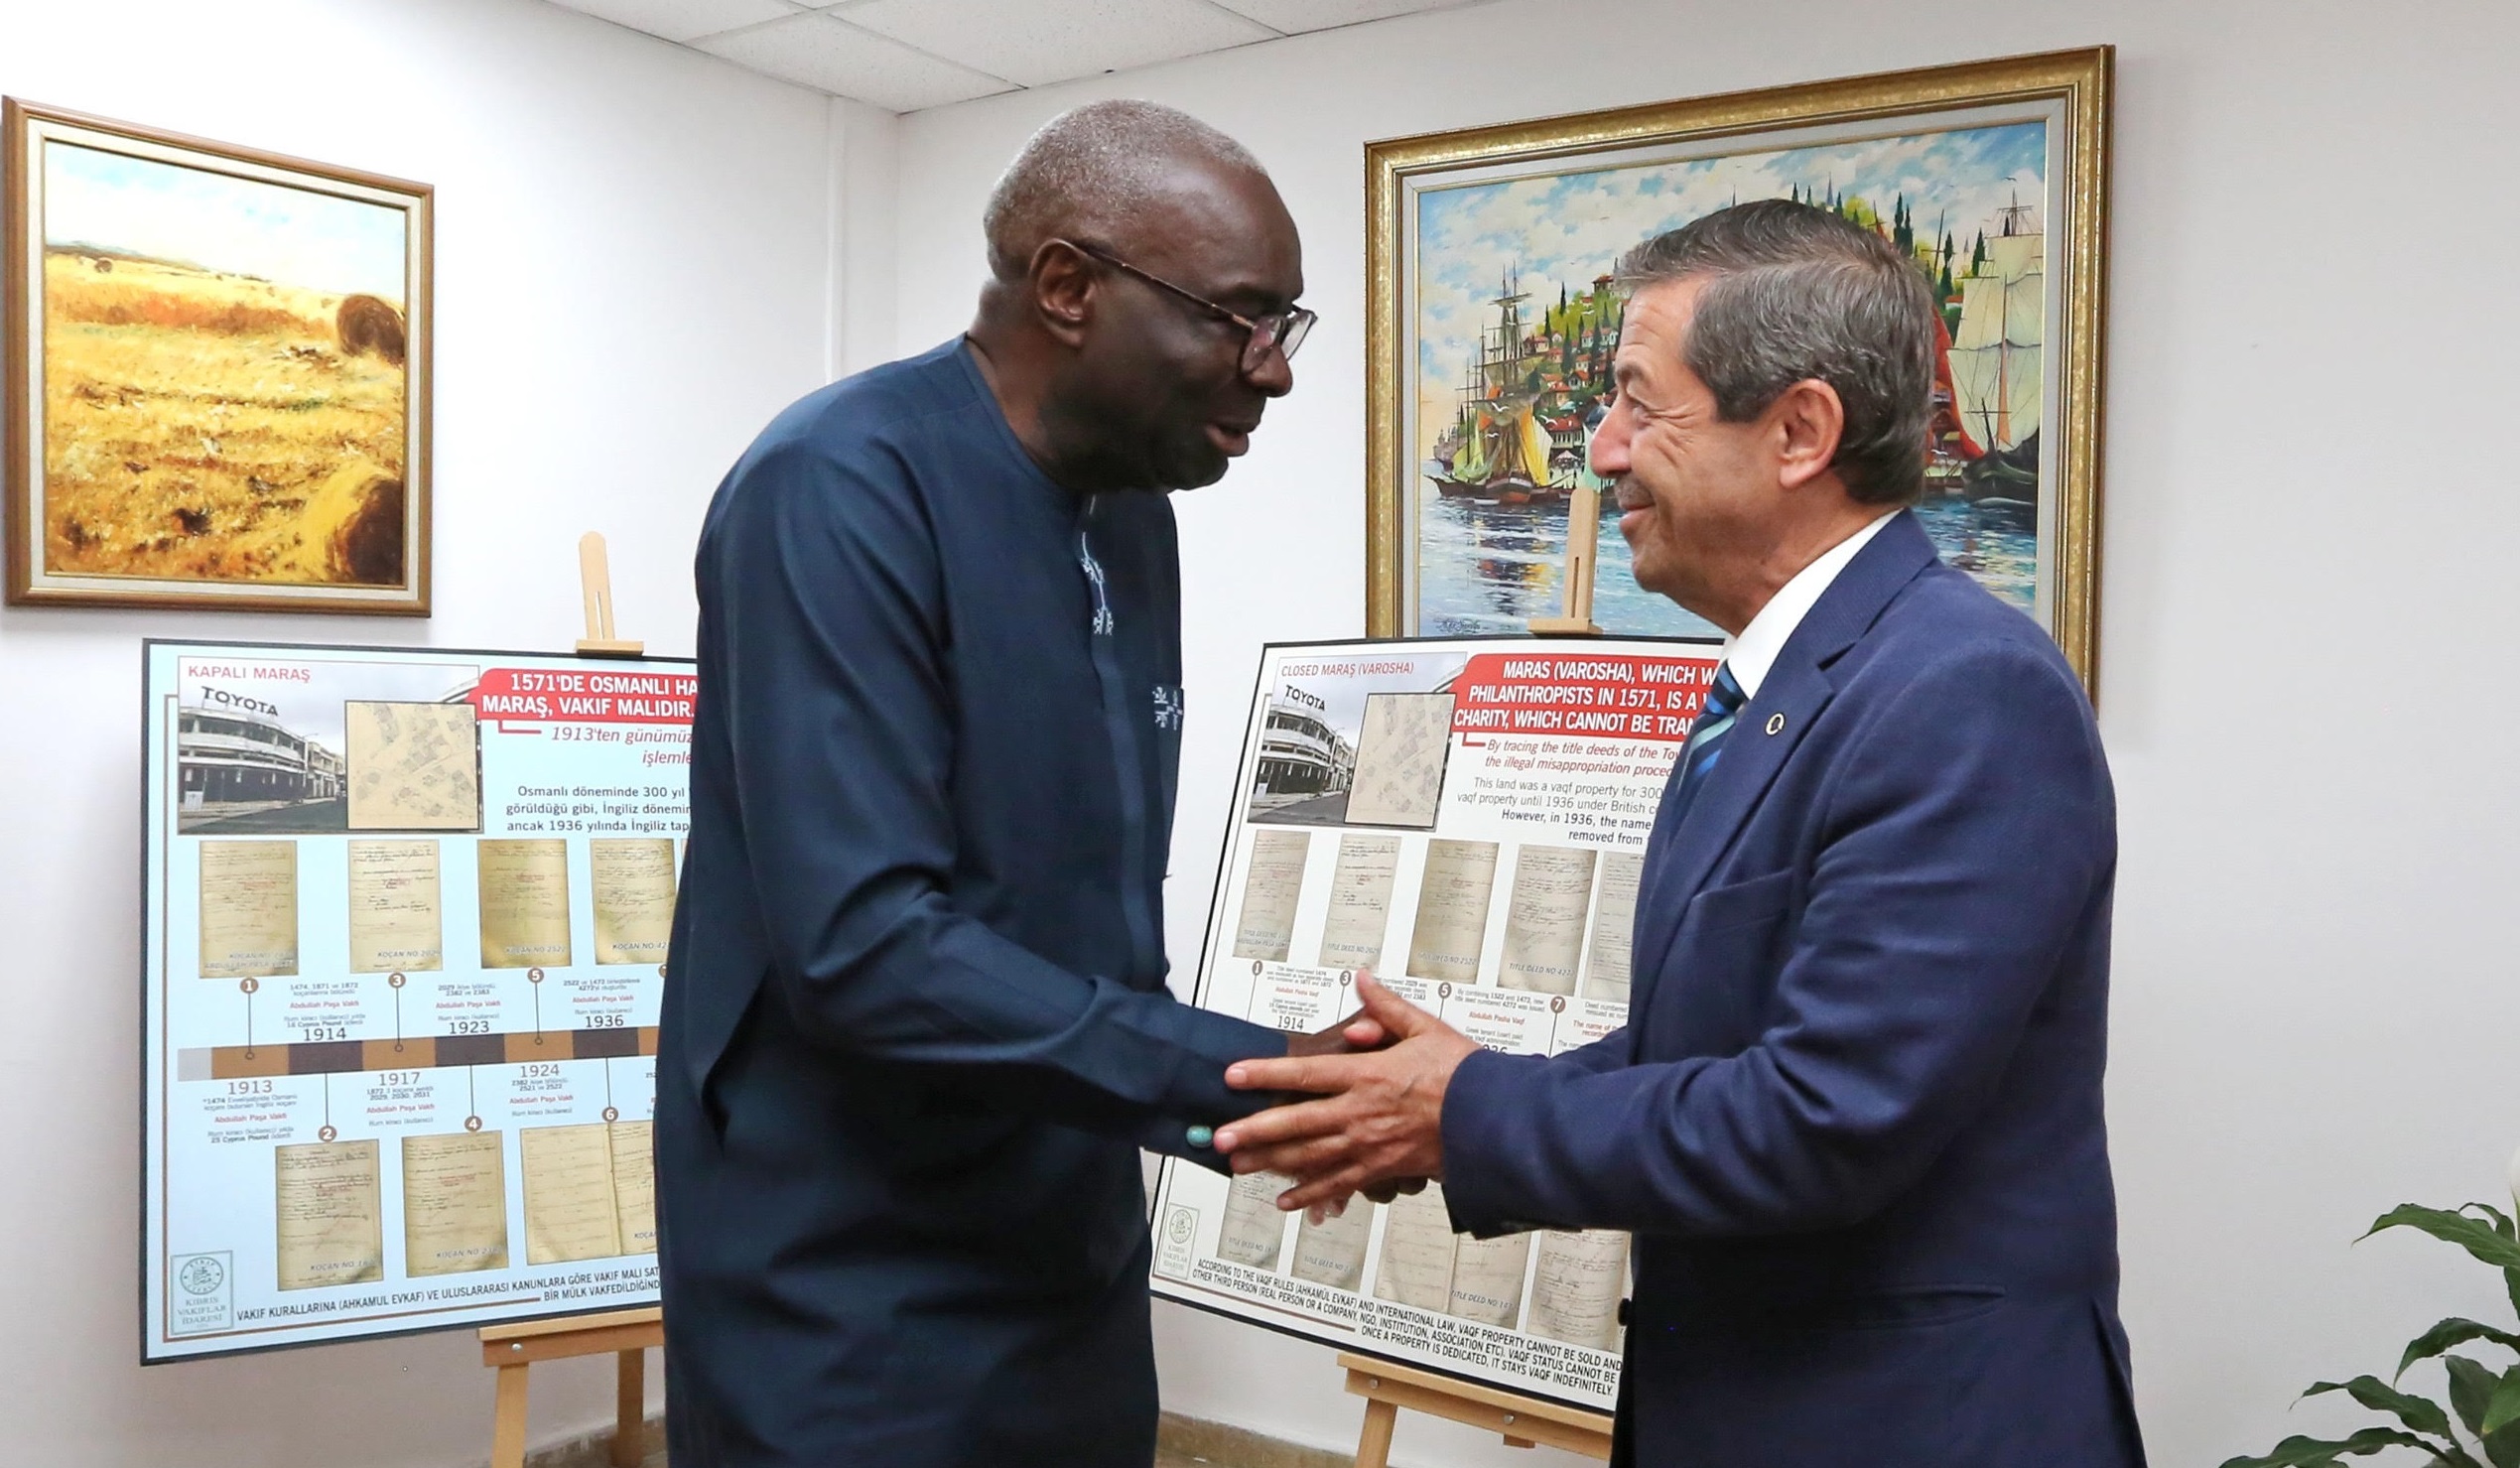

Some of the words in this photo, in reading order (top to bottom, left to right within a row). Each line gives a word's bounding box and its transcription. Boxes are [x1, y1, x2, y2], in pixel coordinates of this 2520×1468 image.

[189, 666, 246, 679] KAPALI
[253, 667, 311, 683] MARAŞ
[1281, 665, 1318, 677] CLOSED
[1320, 663, 1356, 678] MARAŞ
[1358, 661, 1414, 676] (VAROSHA)
[1503, 660, 1550, 680] MARAS
[1554, 661, 1636, 684] (VAROSHA),
[1642, 663, 1695, 685] WHICH
[511, 673, 585, 692] 1571'DE
[590, 676, 670, 695] OSMANLI
[676, 679, 698, 696] HA
[201, 686, 279, 717] TOYOTA
[482, 695, 553, 718] MARAŞ,
[559, 697, 612, 715] VAKIF
[617, 699, 695, 718] MALIDIR.
[1285, 684, 1326, 712] TOYOTA
[1468, 685, 1594, 706] PHILANTHROPISTS
[1597, 687, 1614, 706] IN
[1619, 688, 1660, 712] 1571,
[1666, 691, 1682, 710] IS
[1684, 693, 1697, 711] A
[1454, 709, 1511, 730] CHARITY,
[1514, 711, 1562, 729] WHICH
[1565, 712, 1628, 733] CANNOT
[1631, 715, 1652, 734] BE
[551, 727, 620, 741] 1913'ten
[624, 728, 693, 744] günümüz
[1487, 739, 1500, 753] By
[1503, 740, 1538, 755] tracing
[1541, 741, 1558, 753] the
[1562, 741, 1584, 754] title
[1586, 743, 1620, 756] deeds
[1623, 744, 1637, 757] of
[1639, 745, 1658, 759] the
[1485, 755, 1501, 767] the
[1504, 756, 1534, 771] illegal
[1536, 758, 1631, 775] misappropriation
[517, 785, 569, 797] Osmanlı
[573, 786, 639, 797] döneminde
[643, 787, 667, 797] 300
[672, 787, 685, 799] yıl
[1474, 777, 1494, 789] This
[1496, 778, 1517, 790] land
[1519, 781, 1538, 791] was
[1550, 781, 1573, 795] vaqf
[1575, 783, 1619, 798] property
[1621, 785, 1637, 797] for
[1640, 786, 1663, 799] 300
[506, 803, 568, 815] görüldüğü
[573, 803, 597, 815] gibi,
[602, 801, 638, 816] İngiliz
[1457, 792, 1477, 805] vaqf
[1479, 793, 1518, 806] property
[1521, 795, 1542, 807] until
[1546, 796, 1574, 809] 1936
[1577, 798, 1607, 811] under
[1611, 801, 1646, 814] British
[507, 821, 544, 831] ancak
[549, 820, 583, 832] 1936
[587, 820, 626, 833] yılında
[631, 818, 666, 833] İngiliz
[671, 822, 690, 833] tap
[1502, 809, 1546, 823] However,
[1550, 812, 1560, 823] in
[1564, 812, 1596, 827] 1936,
[1600, 815, 1618, 828] the
[1621, 819, 1652, 831] name
[1568, 830, 1614, 844] removed
[1618, 832, 1643, 845] from
[449, 1020, 490, 1034] 1923
[585, 1014, 624, 1028] 1936
[1277, 1014, 1304, 1031] 1914
[304, 1028, 347, 1041] 1914
[378, 1072, 421, 1087] 1917
[519, 1063, 561, 1078] 1924
[227, 1080, 273, 1095] 1913
[237, 1309, 265, 1321] VAKIF
[269, 1301, 337, 1318] KURALLARINA
[338, 1295, 389, 1311] (AHKAMUL
[391, 1291, 425, 1304] EVKAF)
[427, 1289, 439, 1300] VE
[442, 1282, 509, 1299] ULUSLARARASI
[512, 1276, 566, 1291] KANUNLARA
[568, 1272, 593, 1284] GÖRE
[594, 1270, 618, 1282] VAKIF
[621, 1268, 642, 1279] MALI
[544, 1288, 559, 1301] BİR
[562, 1285, 588, 1298] MÜLK
[1198, 1259, 1232, 1276] ACCORDING
[1233, 1268, 1242, 1278] TO
[1243, 1269, 1255, 1282] THE
[1256, 1272, 1272, 1286] VAQF
[1274, 1276, 1294, 1292] RULES
[1332, 1292, 1357, 1308] EVKAF)
[1358, 1300, 1375, 1312] AND
[1376, 1304, 1434, 1329] INTERNATIONAL
[1437, 1318, 1456, 1333] LAW,
[1458, 1323, 1480, 1338] VAQF
[1481, 1328, 1525, 1349] PROPERTY
[1526, 1340, 1561, 1357] CANNOT
[1563, 1348, 1575, 1361] BE
[1578, 1351, 1601, 1367] SOLD
[1603, 1358, 1623, 1372] AND
[1192, 1268, 1212, 1282] OTHER
[1213, 1273, 1232, 1287] THIRD
[1233, 1278, 1258, 1294] PERSON
[1259, 1284, 1276, 1300] (REAL
[1278, 1290, 1305, 1306] PERSON
[1306, 1297, 1316, 1309] OR
[1323, 1303, 1358, 1321] COMPANY,
[1359, 1313, 1377, 1326] NGO,
[1380, 1317, 1429, 1339] INSTITUTION,
[1431, 1330, 1483, 1352] ASSOCIATION
[1486, 1342, 1506, 1358] ETC).
[1509, 1349, 1530, 1363] VAQF
[1532, 1354, 1564, 1372] STATUS
[1565, 1362, 1602, 1380] CANNOT
[1604, 1371, 1617, 1384] BE
[1361, 1325, 1382, 1340] ONCE
[1391, 1332, 1430, 1352] PROPERTY
[1432, 1343, 1441, 1354] IS
[1442, 1345, 1490, 1368] DEDICATED,
[1491, 1358, 1499, 1369] IT
[1501, 1360, 1526, 1376] STAYS
[1528, 1366, 1551, 1381] VAQF
[1553, 1372, 1613, 1397] INDEFINITELY.
